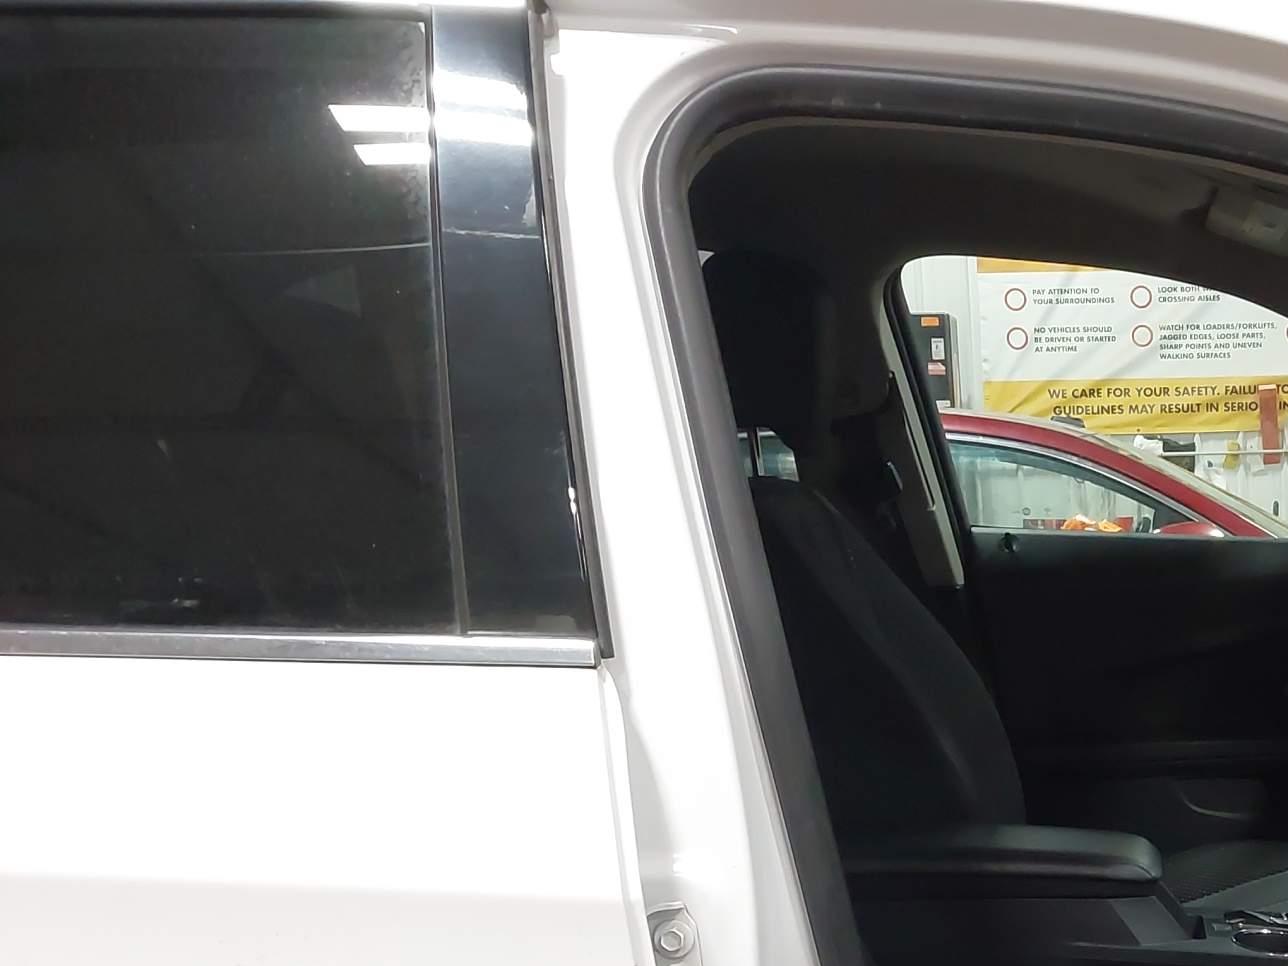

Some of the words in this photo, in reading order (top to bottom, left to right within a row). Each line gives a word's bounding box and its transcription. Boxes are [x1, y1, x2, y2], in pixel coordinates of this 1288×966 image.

[1048, 389, 1067, 398] WE
[1072, 388, 1102, 398] CARE
[1107, 388, 1131, 397] FOR
[1136, 387, 1170, 397] YOUR
[1175, 386, 1220, 396] SAFETY.
[1225, 385, 1257, 395] FAILU
[1053, 405, 1124, 415] GUIDELINES
[1129, 404, 1155, 414] MAY
[1160, 403, 1201, 413] RESULT
[1206, 403, 1219, 412] IN
[1224, 401, 1258, 411] SERIO
